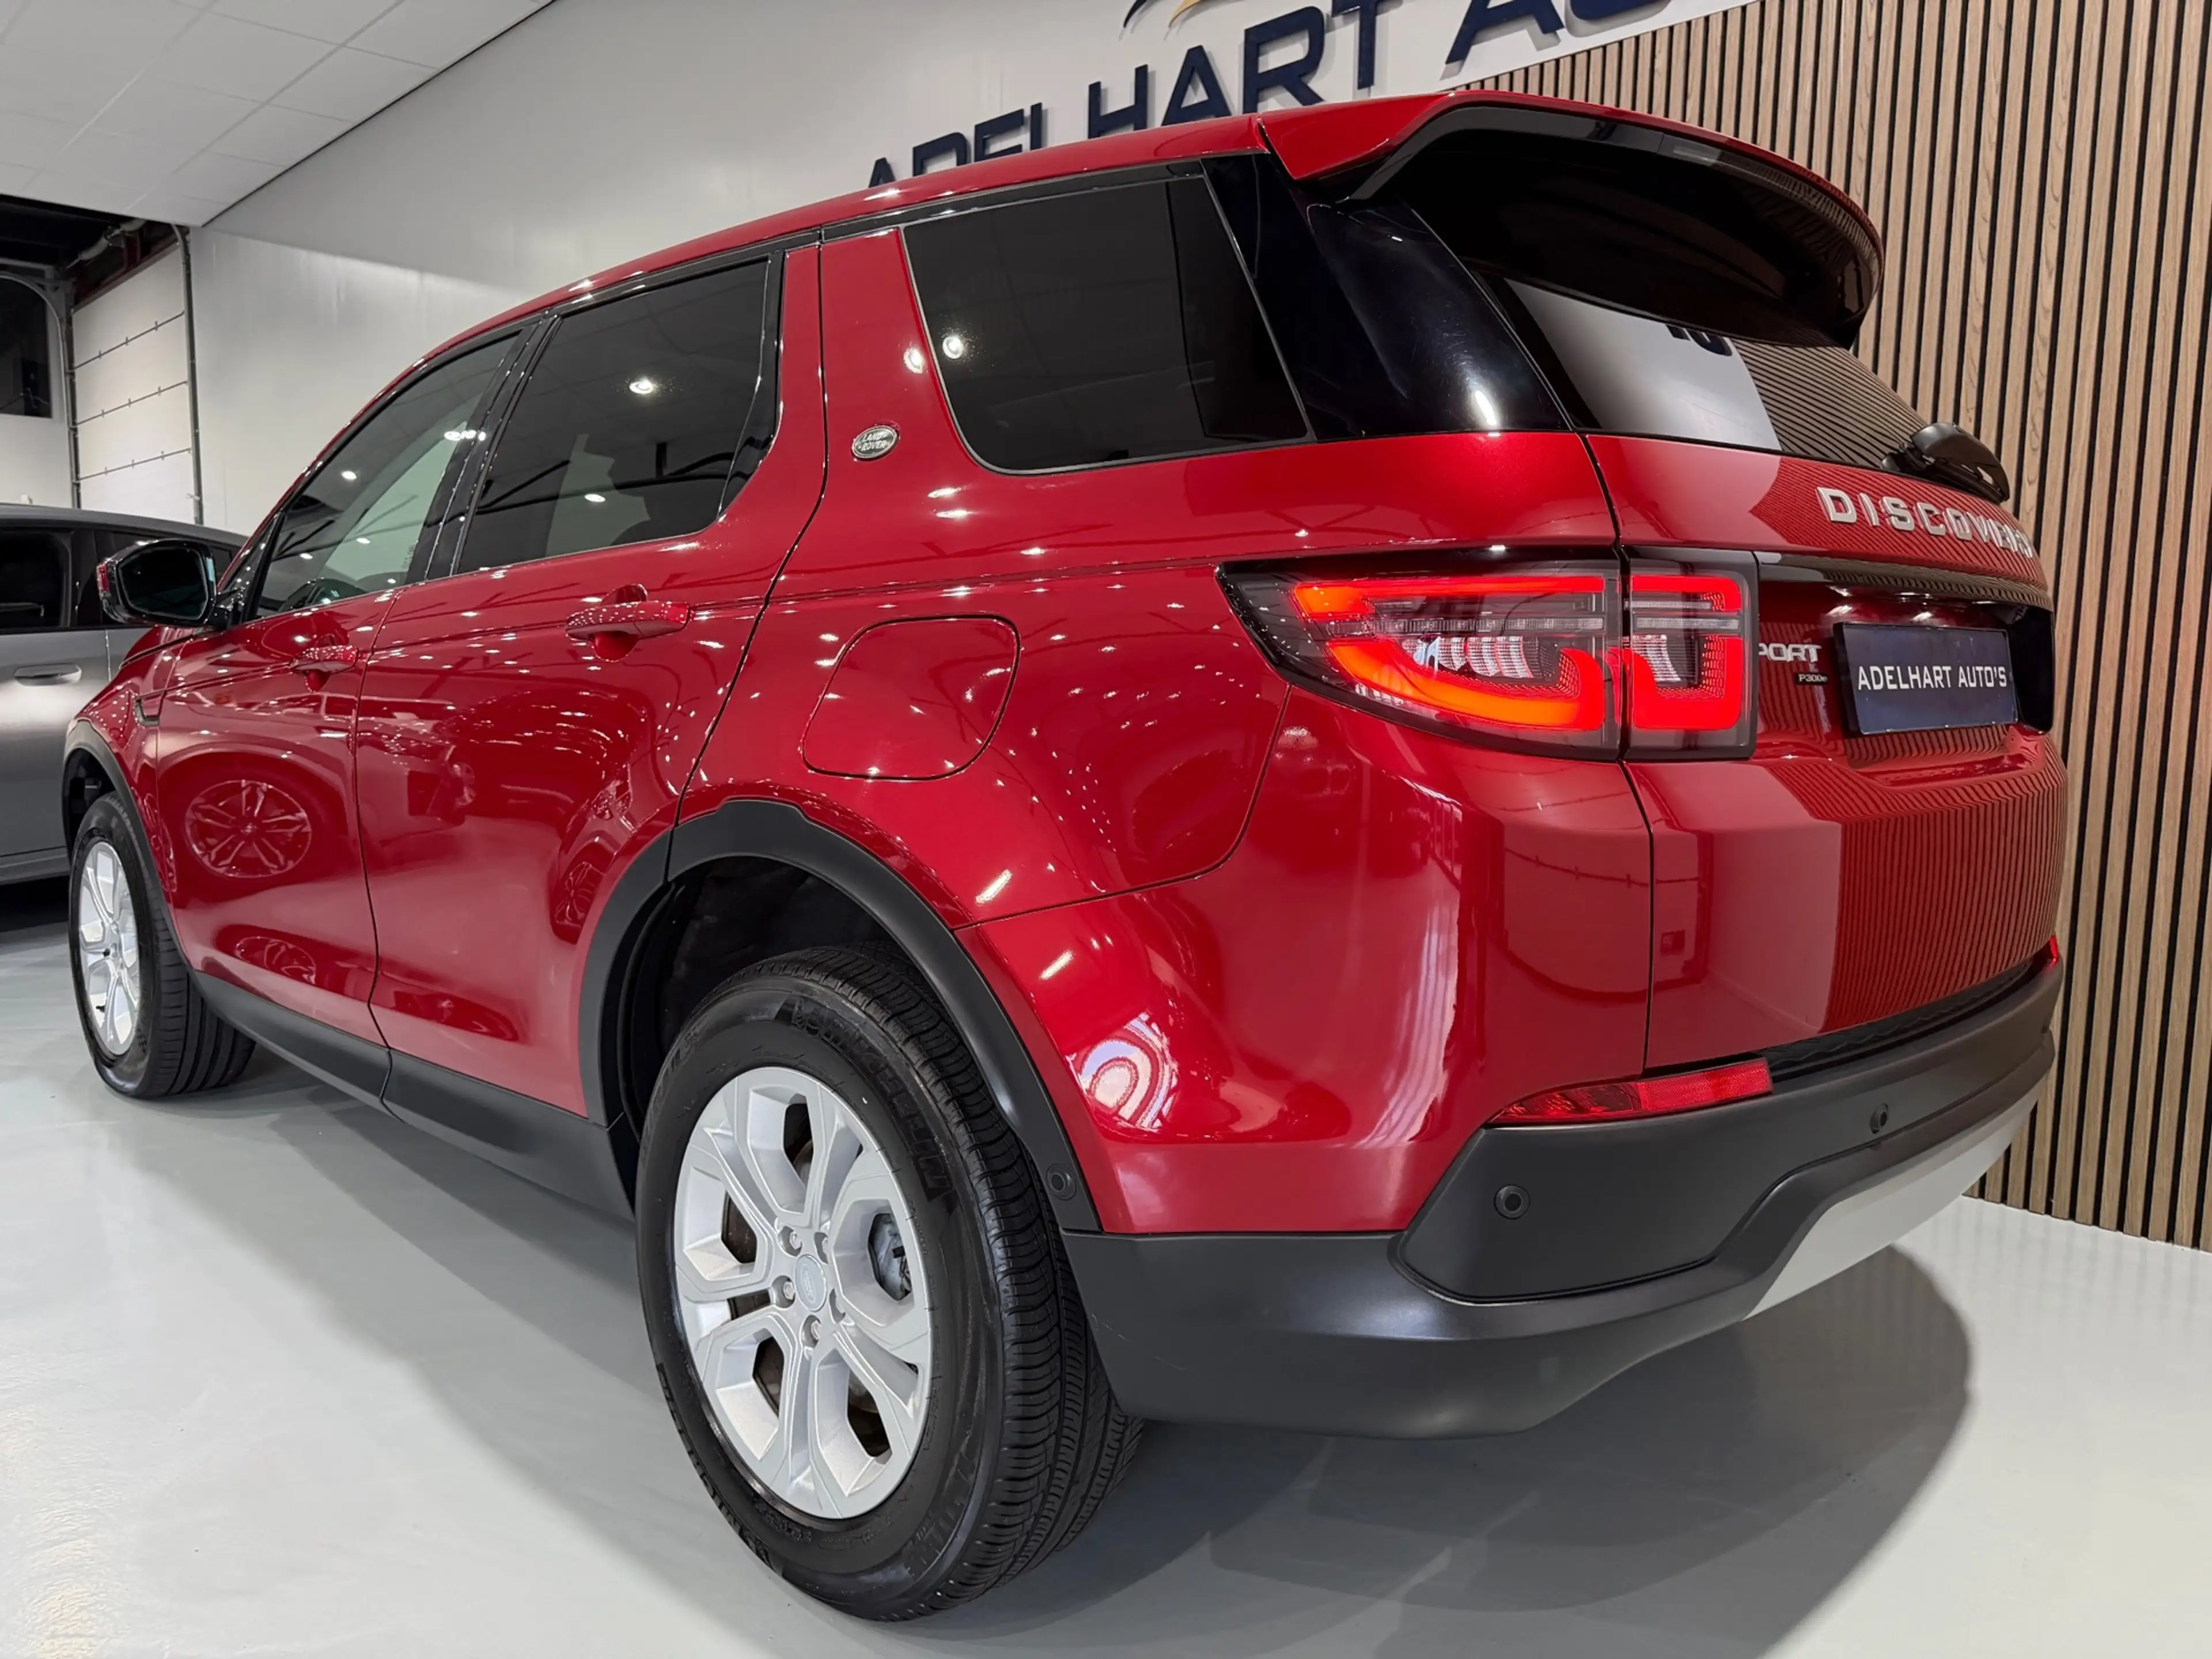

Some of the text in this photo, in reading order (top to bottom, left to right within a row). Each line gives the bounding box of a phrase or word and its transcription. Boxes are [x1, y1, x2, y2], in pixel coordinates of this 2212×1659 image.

[861, 430, 885, 443] LAND
[861, 440, 888, 451] ROVER
[1758, 643, 1822, 662] PORT
[1798, 673, 1828, 682] P300e
[1858, 666, 2007, 690] ADELHART AUTO'S
